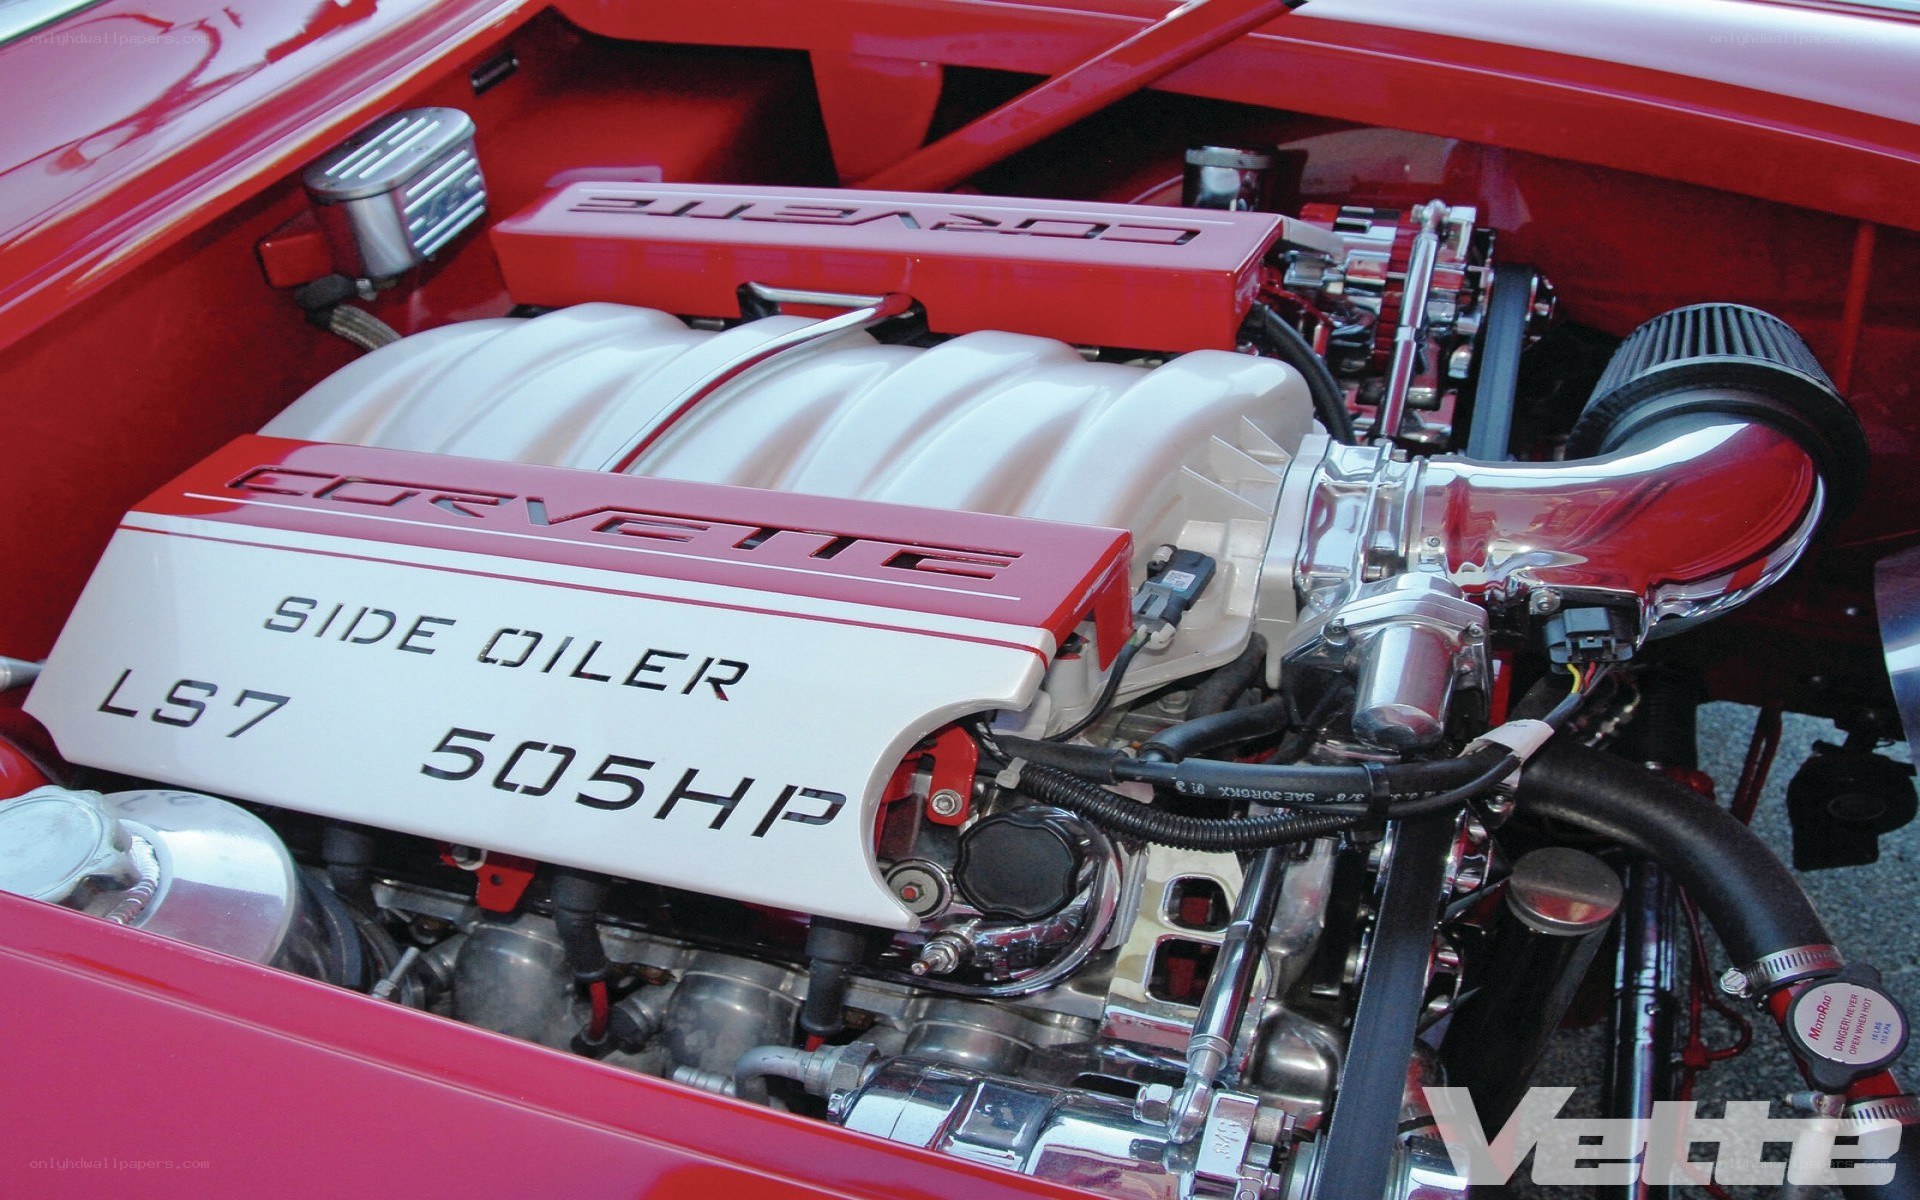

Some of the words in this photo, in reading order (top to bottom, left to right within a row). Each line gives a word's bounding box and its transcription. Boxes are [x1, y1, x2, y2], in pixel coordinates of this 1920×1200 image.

[567, 196, 1202, 246] CORVETTE
[225, 463, 1025, 581] CORVETTE
[264, 595, 456, 655] SIDE
[477, 626, 750, 702] OILER
[98, 667, 291, 739] LS7
[419, 726, 848, 839] 505HP
[1833, 1017, 1850, 1052] DANGER!
[1846, 994, 1859, 1018] NEVER
[1849, 1034, 1860, 1055] OPEN
[1855, 1014, 1867, 1035] WHEN
[1862, 998, 1872, 1014] HOT
